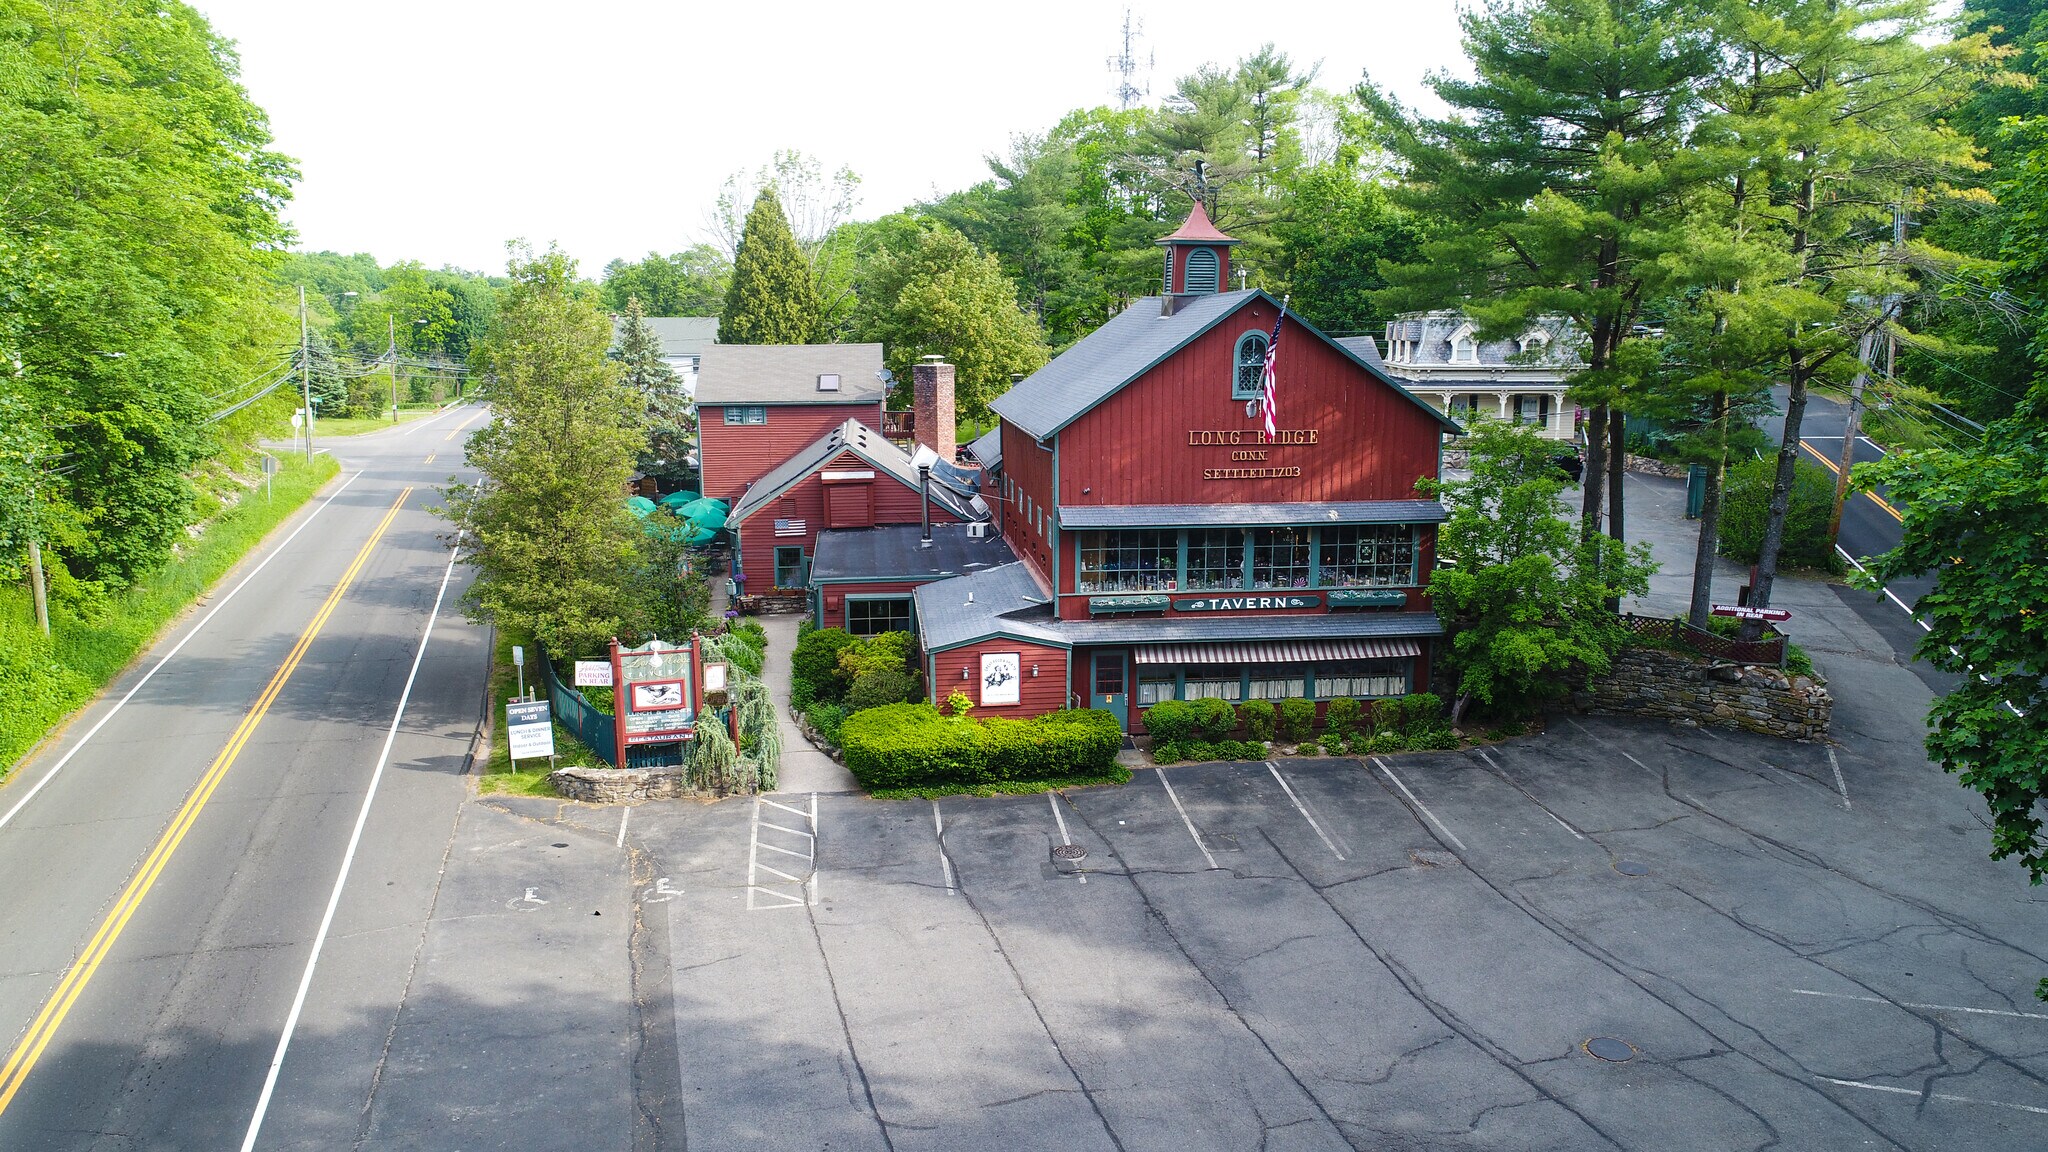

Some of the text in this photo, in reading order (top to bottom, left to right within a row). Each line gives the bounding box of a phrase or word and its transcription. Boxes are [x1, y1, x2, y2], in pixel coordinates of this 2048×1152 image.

[1188, 430, 1318, 445] LONG RIDGE
[1231, 450, 1268, 461] CONN.
[1203, 466, 1301, 479] SETTLED 1703
[1209, 597, 1287, 610] TAVERN
[628, 669, 686, 678] TAVERN
